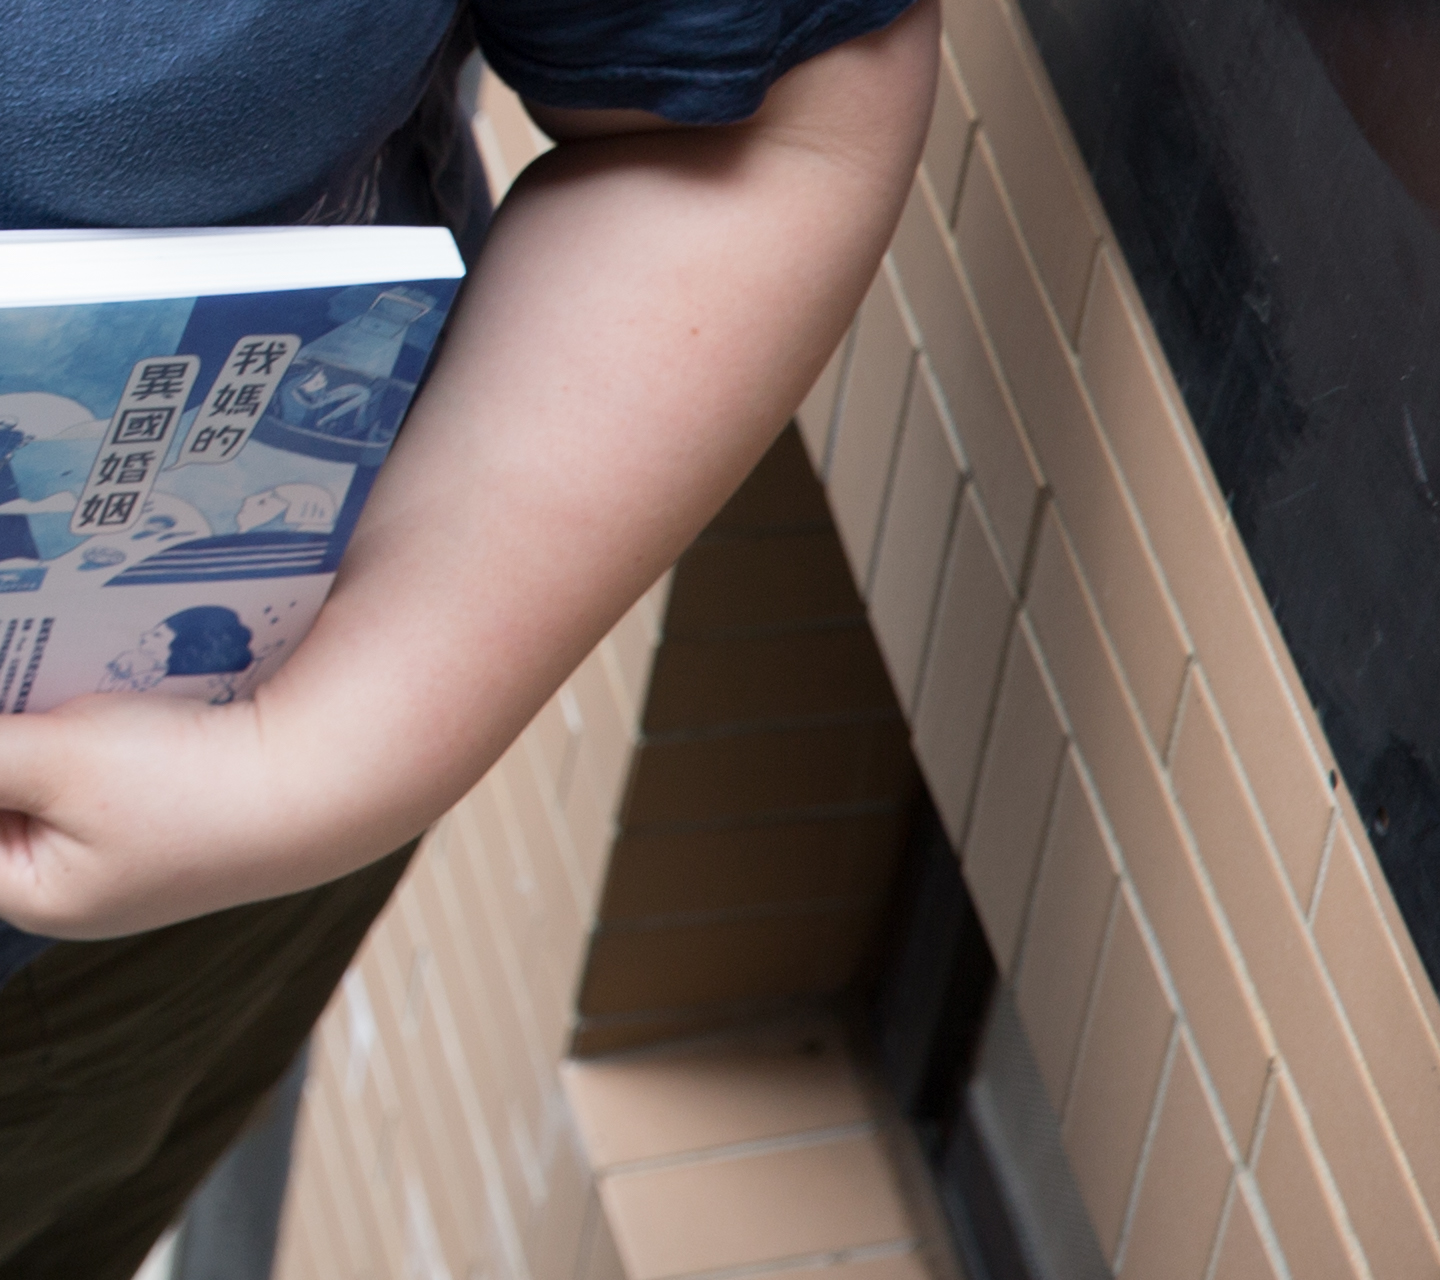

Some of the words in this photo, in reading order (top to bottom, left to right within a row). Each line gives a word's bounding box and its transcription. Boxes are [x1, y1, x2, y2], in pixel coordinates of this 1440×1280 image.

[77, 362, 189, 528] 異國婚姻
[189, 341, 287, 458] 我媽的
